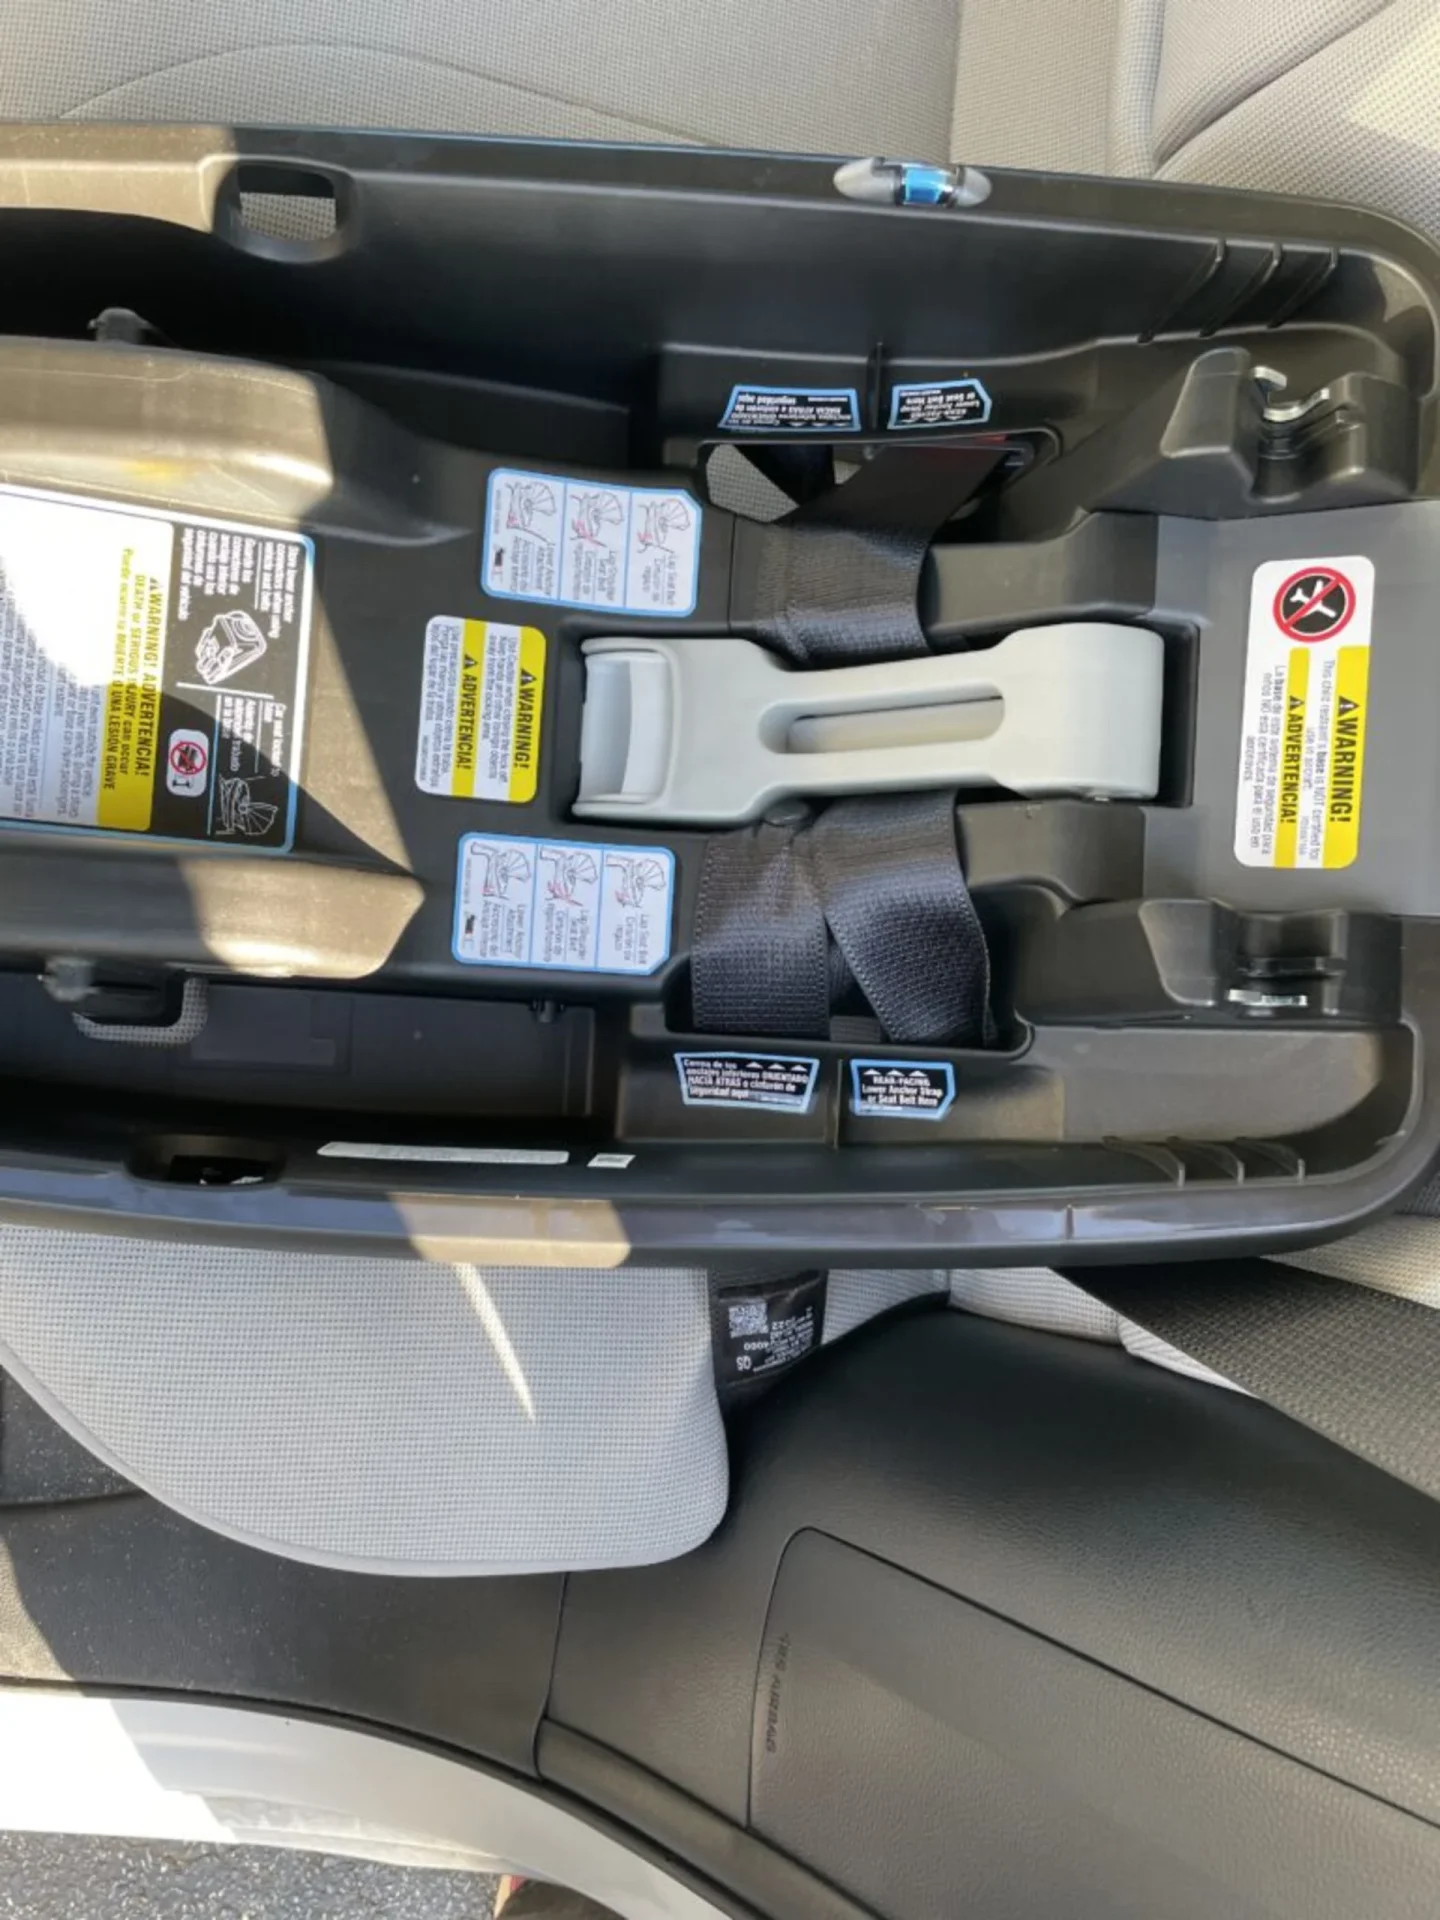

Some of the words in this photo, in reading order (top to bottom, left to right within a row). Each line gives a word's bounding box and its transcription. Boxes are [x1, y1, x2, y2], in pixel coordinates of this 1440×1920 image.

[143, 591, 162, 667] WARNING!
[108, 690, 121, 713] UNA
[134, 672, 157, 777] ADVERTENCIA!
[456, 673, 477, 769] ADVERTENCIA!
[513, 687, 534, 768] WARNING!
[102, 748, 117, 790] GRAVE
[1279, 712, 1304, 824] ADVERTENCIA!
[1329, 715, 1357, 823] WARNING!
[862, 1083, 886, 1093] Lower
[888, 1085, 917, 1094] Anchor
[878, 1094, 896, 1104] Seat
[899, 1094, 915, 1104] Belt
